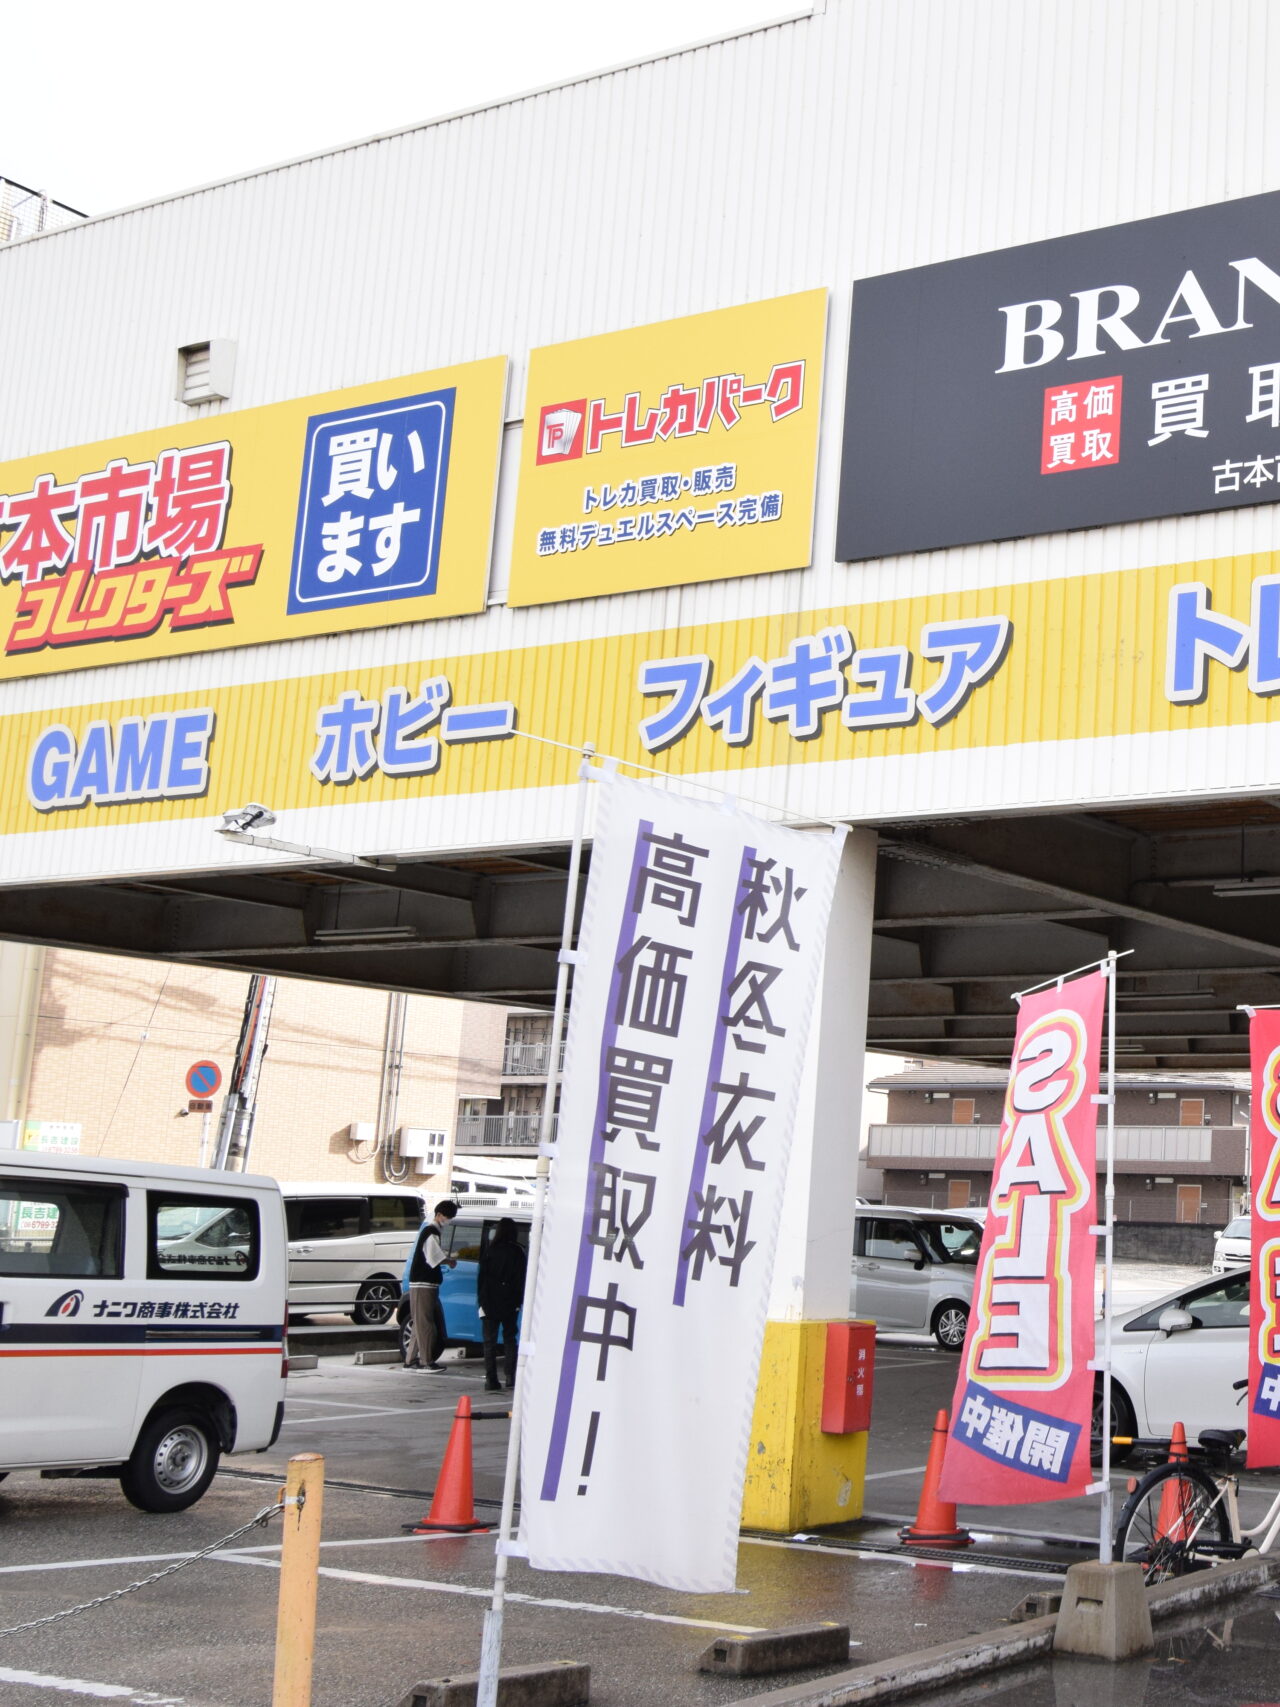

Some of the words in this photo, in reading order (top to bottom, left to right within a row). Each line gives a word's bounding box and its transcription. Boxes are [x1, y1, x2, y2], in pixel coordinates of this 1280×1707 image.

[586, 360, 806, 454] トレカパーク
[1049, 385, 1115, 423] 高価
[320, 427, 427, 506] 買い
[584, 463, 737, 512] トレカ買取・販売
[1047, 429, 1114, 468] 買取
[0, 440, 231, 587] 本市場
[316, 504, 421, 583] ます
[538, 491, 782, 555] 無料デュエルスペース完備
[8, 549, 260, 648] コレクターズ
[639, 615, 1013, 755] フィギュア
[28, 707, 215, 812] GAME
[311, 675, 517, 784] ホビー
[683, 855, 808, 1288] 秋冬衣料
[92, 1300, 240, 1320] ナニワ商事株式会社
